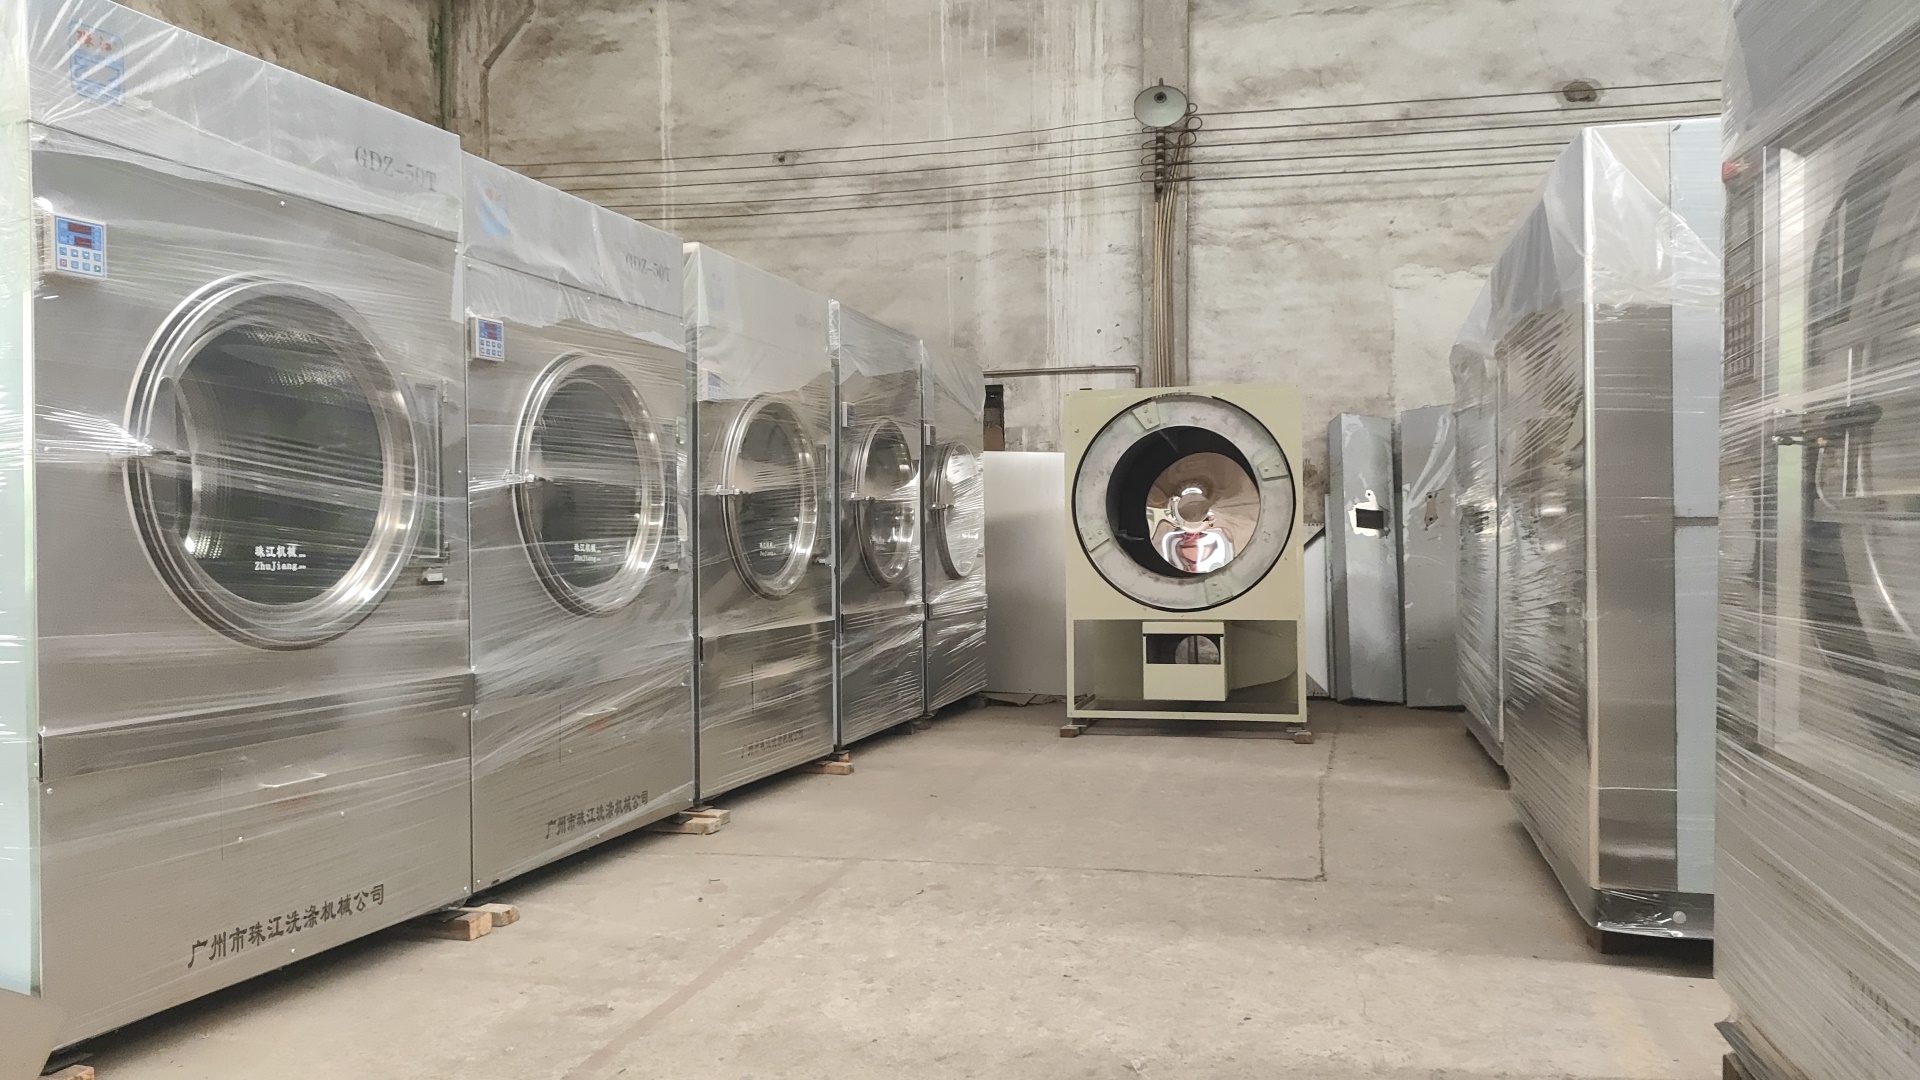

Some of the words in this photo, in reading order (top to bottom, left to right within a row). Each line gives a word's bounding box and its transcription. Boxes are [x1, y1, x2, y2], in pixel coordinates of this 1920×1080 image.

[355, 145, 437, 193] GDZ-50T
[187, 883, 385, 969] 广州市珠江洗涤机械公司
